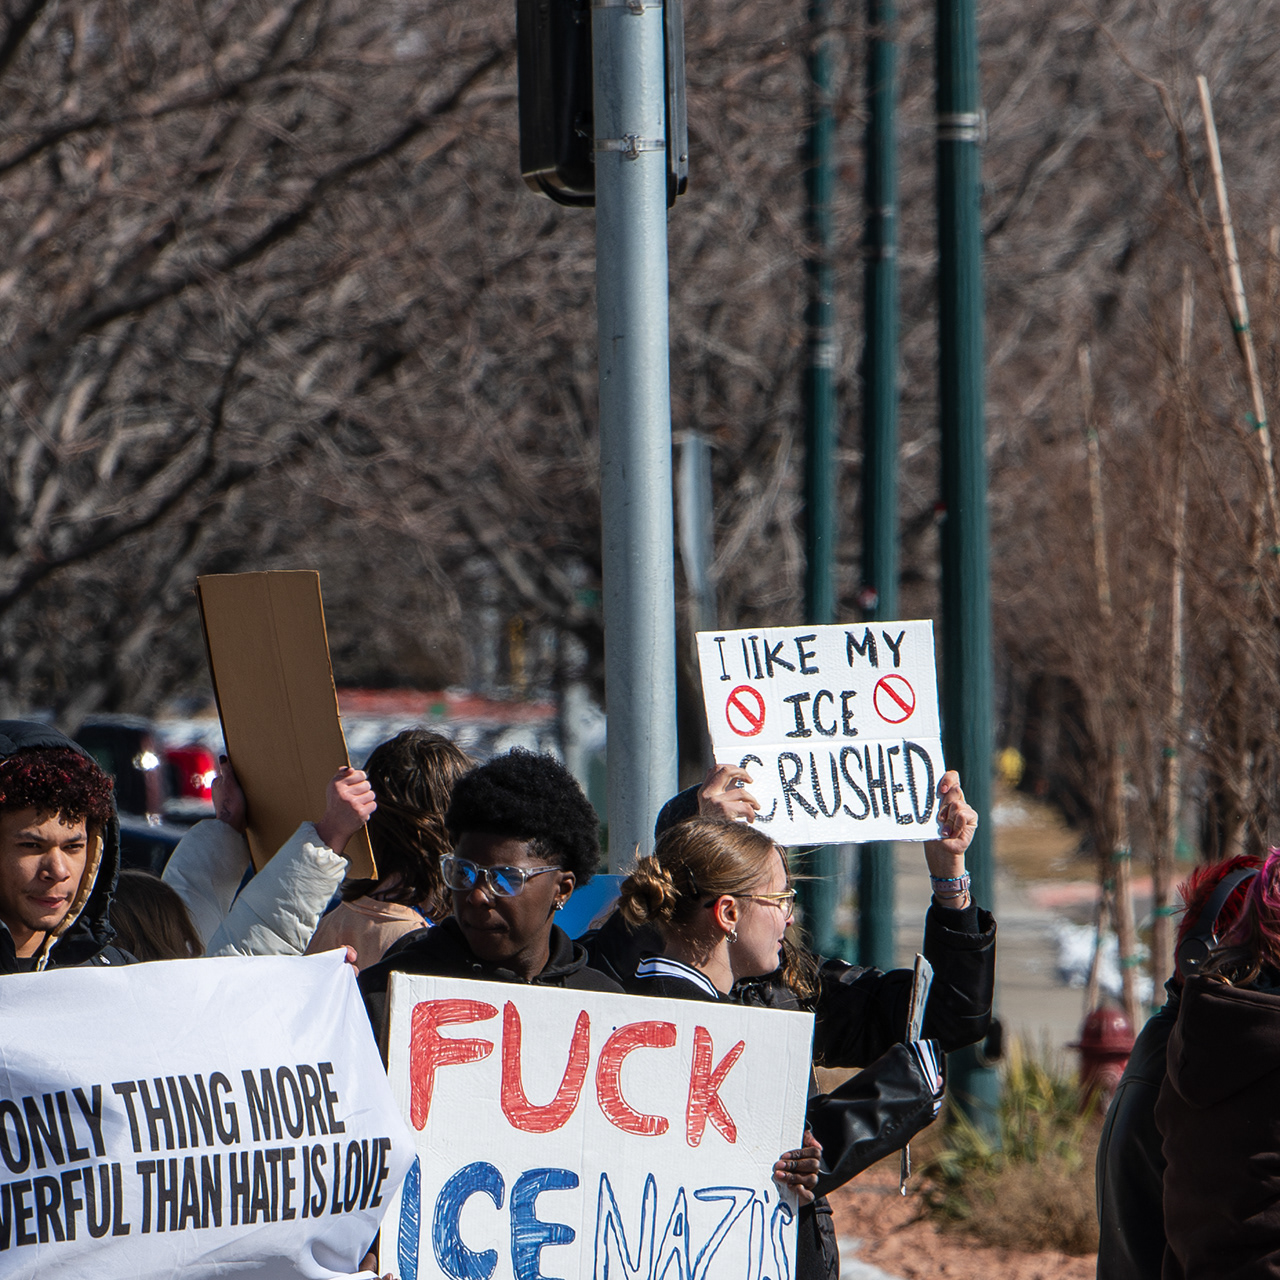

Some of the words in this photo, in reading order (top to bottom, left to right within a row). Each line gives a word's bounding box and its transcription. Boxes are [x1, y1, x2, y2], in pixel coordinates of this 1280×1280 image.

[714, 637, 731, 681] I
[844, 627, 905, 668] MY
[783, 690, 858, 738] ICE
[736, 739, 936, 826] CRUSHED
[113, 1071, 240, 1154] THING
[241, 1061, 346, 1143] MORE
[410, 998, 746, 1148] FUCK
[136, 1153, 229, 1233] THAN
[229, 1147, 297, 1225] HATE
[302, 1143, 328, 1219] IS
[331, 1137, 391, 1214] LOVE
